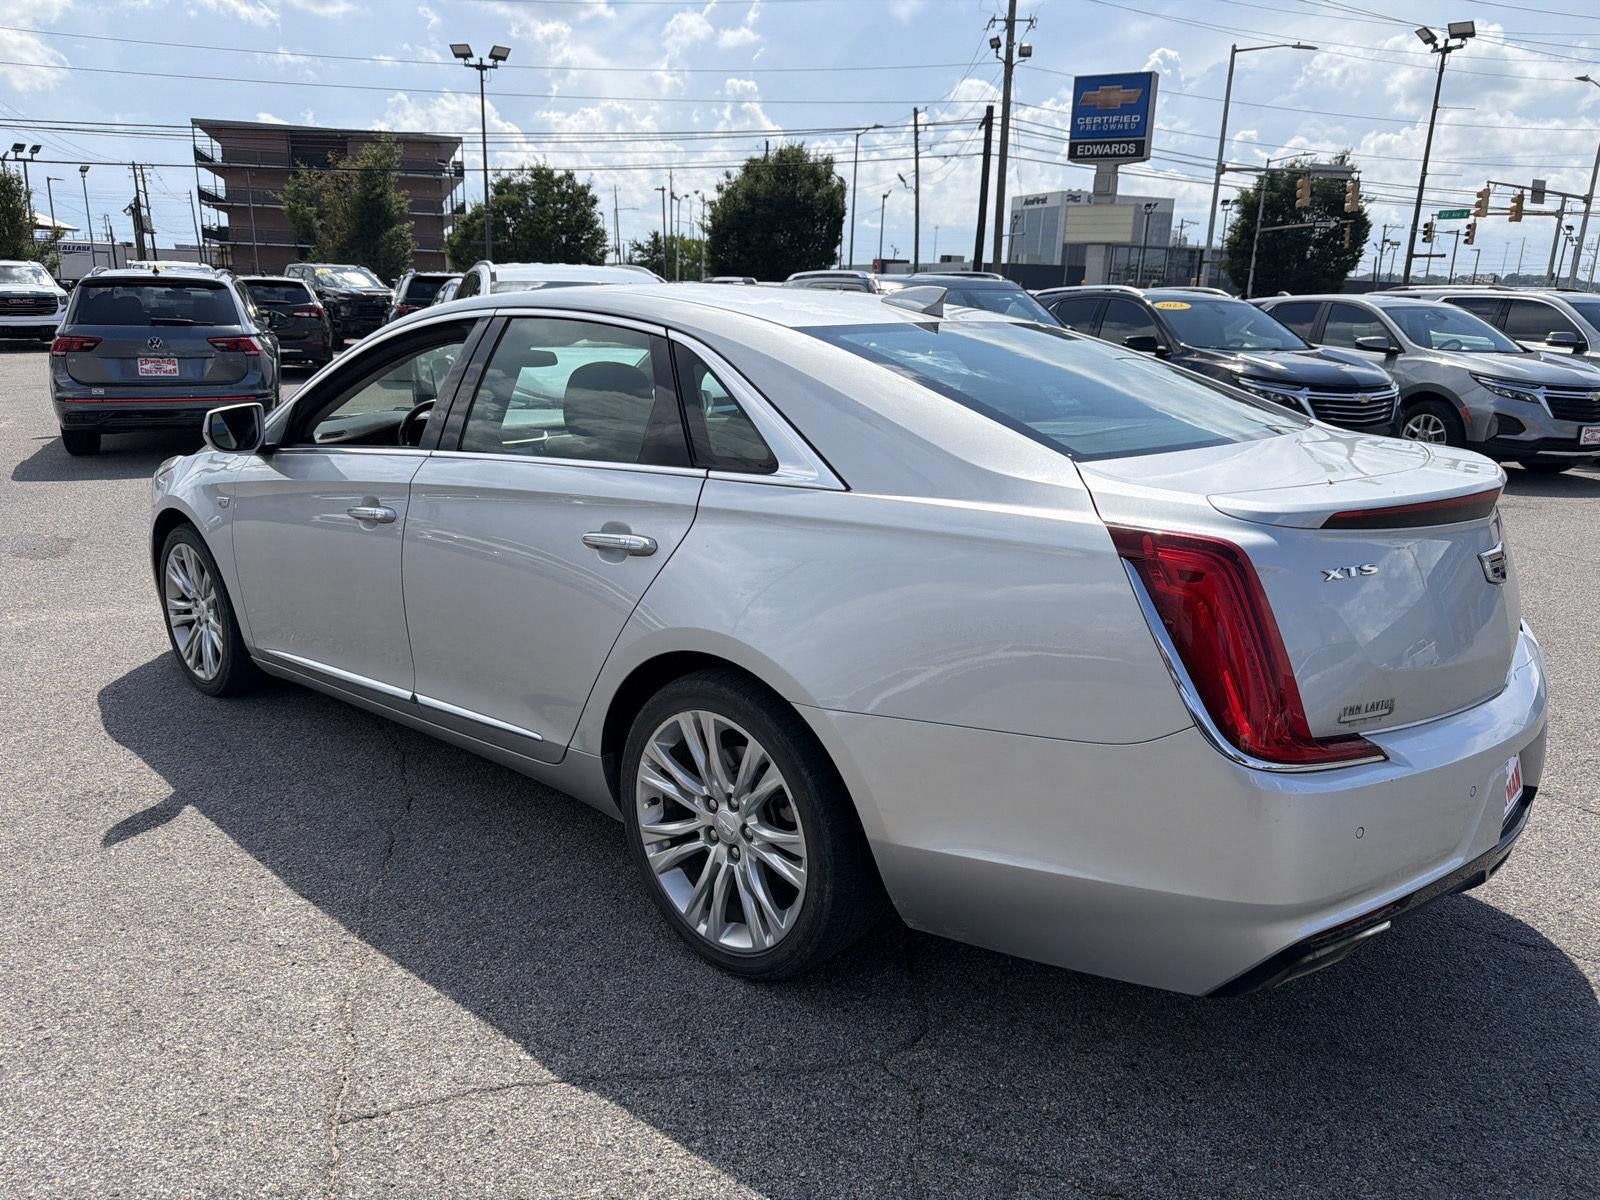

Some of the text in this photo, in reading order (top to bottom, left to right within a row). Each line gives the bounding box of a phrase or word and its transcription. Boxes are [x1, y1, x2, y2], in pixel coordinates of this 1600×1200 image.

[1077, 115, 1141, 125] CERTIFIED
[1076, 143, 1136, 156] EDWARDS
[1320, 563, 1379, 582] XTS
